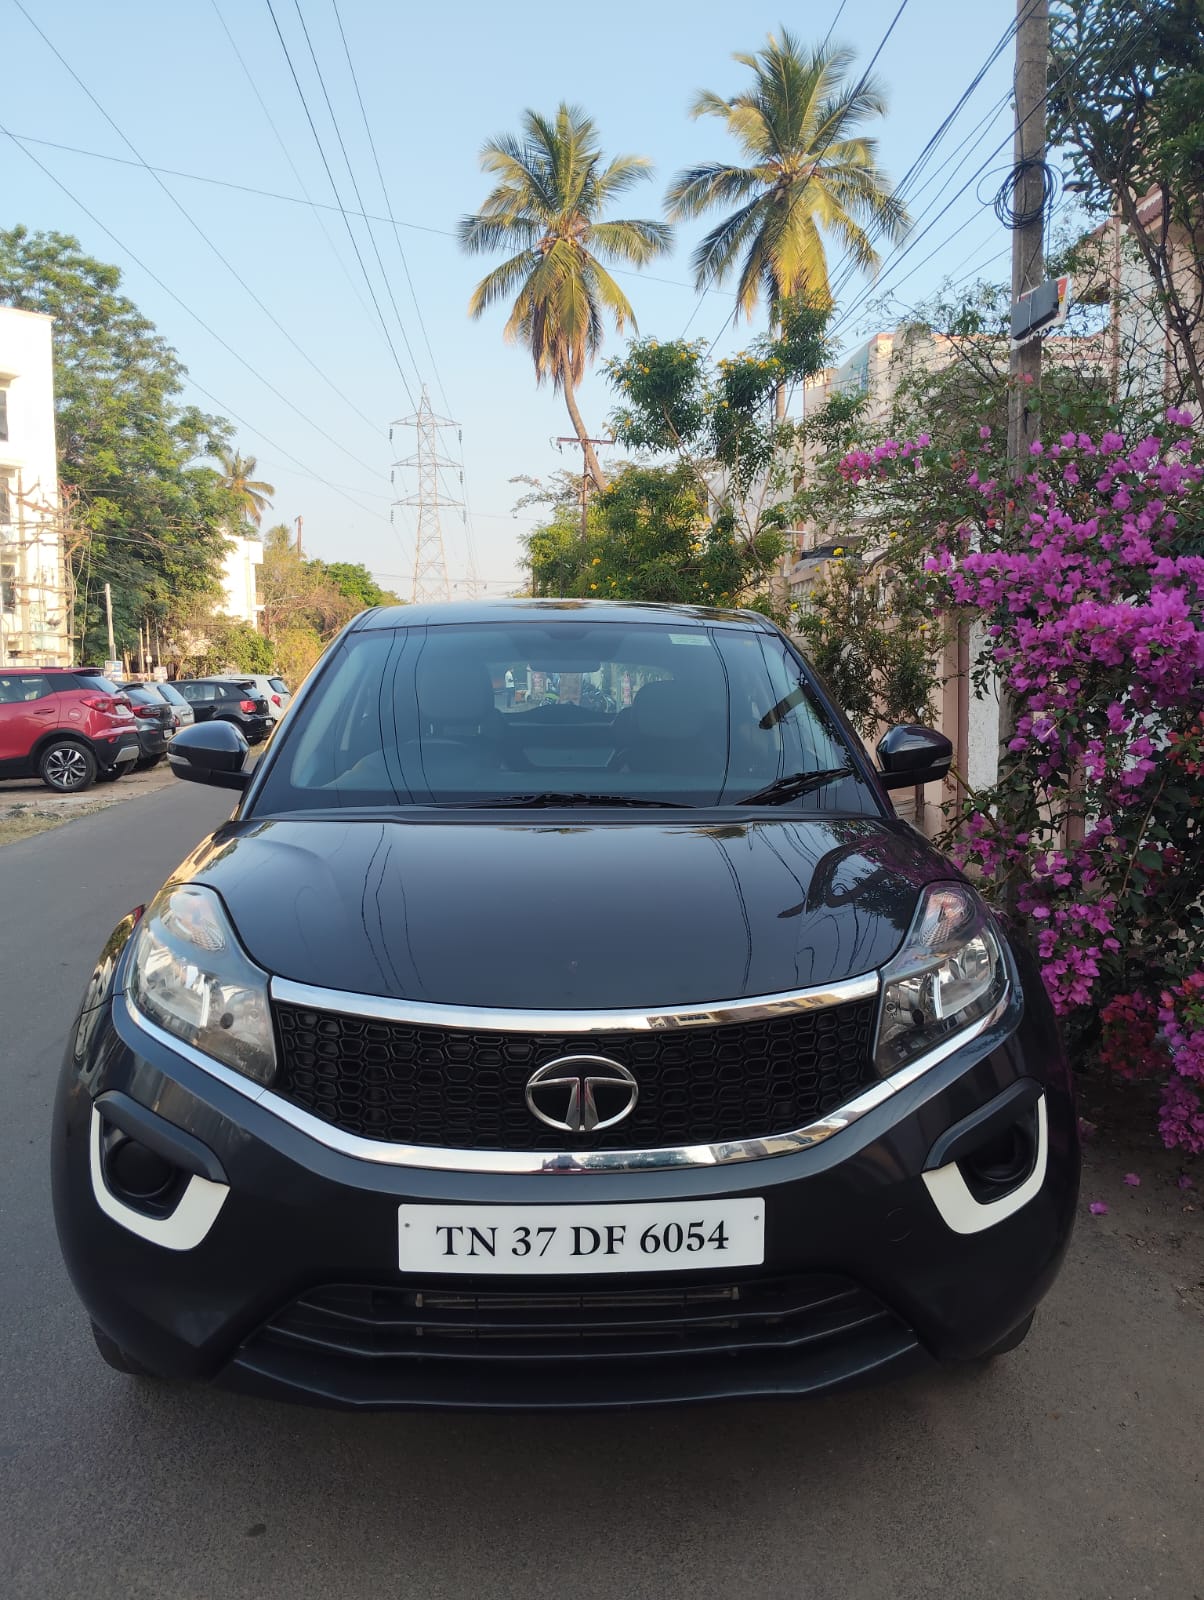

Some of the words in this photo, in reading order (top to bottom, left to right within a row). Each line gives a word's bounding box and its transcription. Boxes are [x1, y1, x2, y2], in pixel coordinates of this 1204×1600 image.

[435, 1226, 498, 1257] TN
[511, 1226, 557, 1257] 37
[569, 1225, 627, 1256] DF
[639, 1220, 729, 1254] 6054
